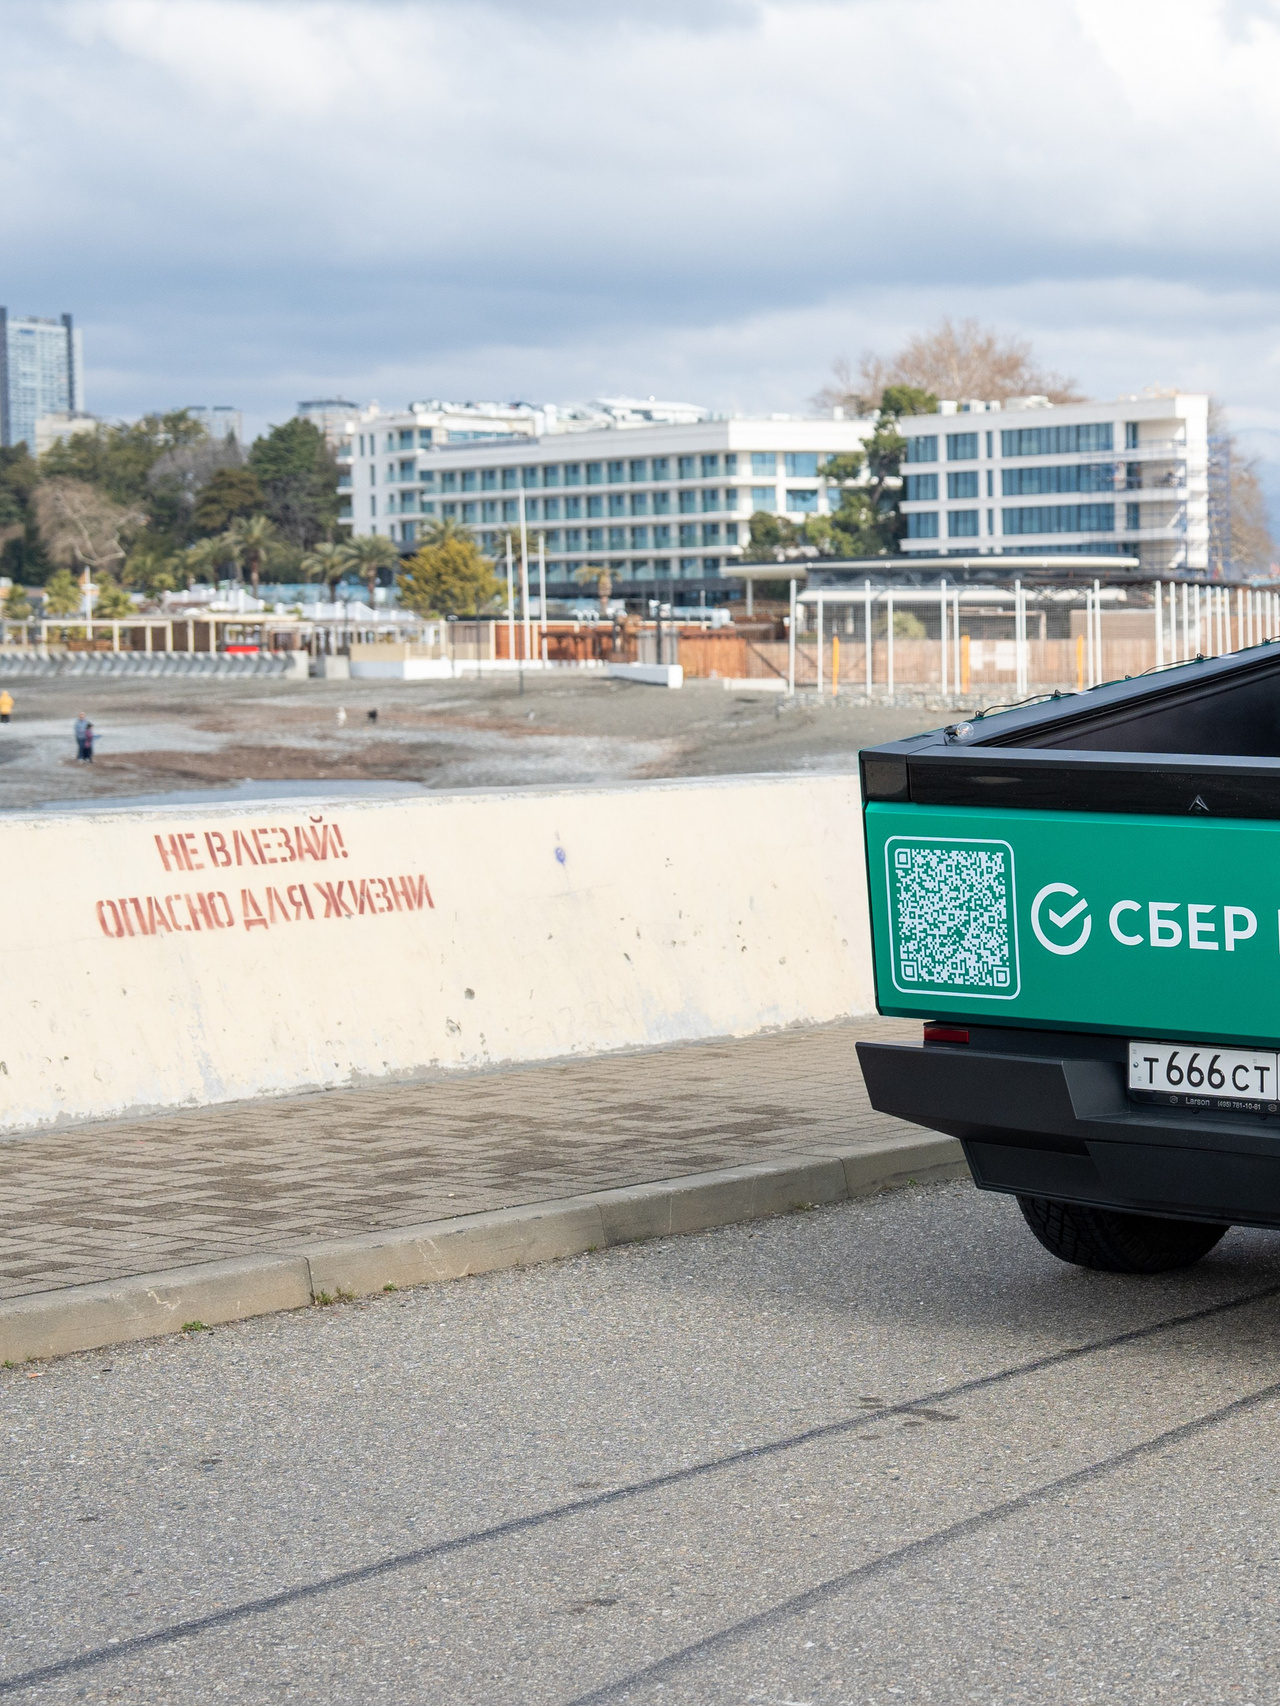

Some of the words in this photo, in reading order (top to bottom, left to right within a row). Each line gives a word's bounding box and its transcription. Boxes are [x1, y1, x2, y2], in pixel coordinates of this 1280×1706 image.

[154, 833, 206, 872] НЕ
[203, 815, 349, 868] ВЛЕЗАЙ!
[96, 890, 236, 938] ОПАСНО
[240, 883, 315, 932] ДЛЯ
[313, 874, 436, 920] ЖИЗНИ
[1108, 899, 1258, 952] СБЕР
[1185, 1096, 1211, 1107] Larson
